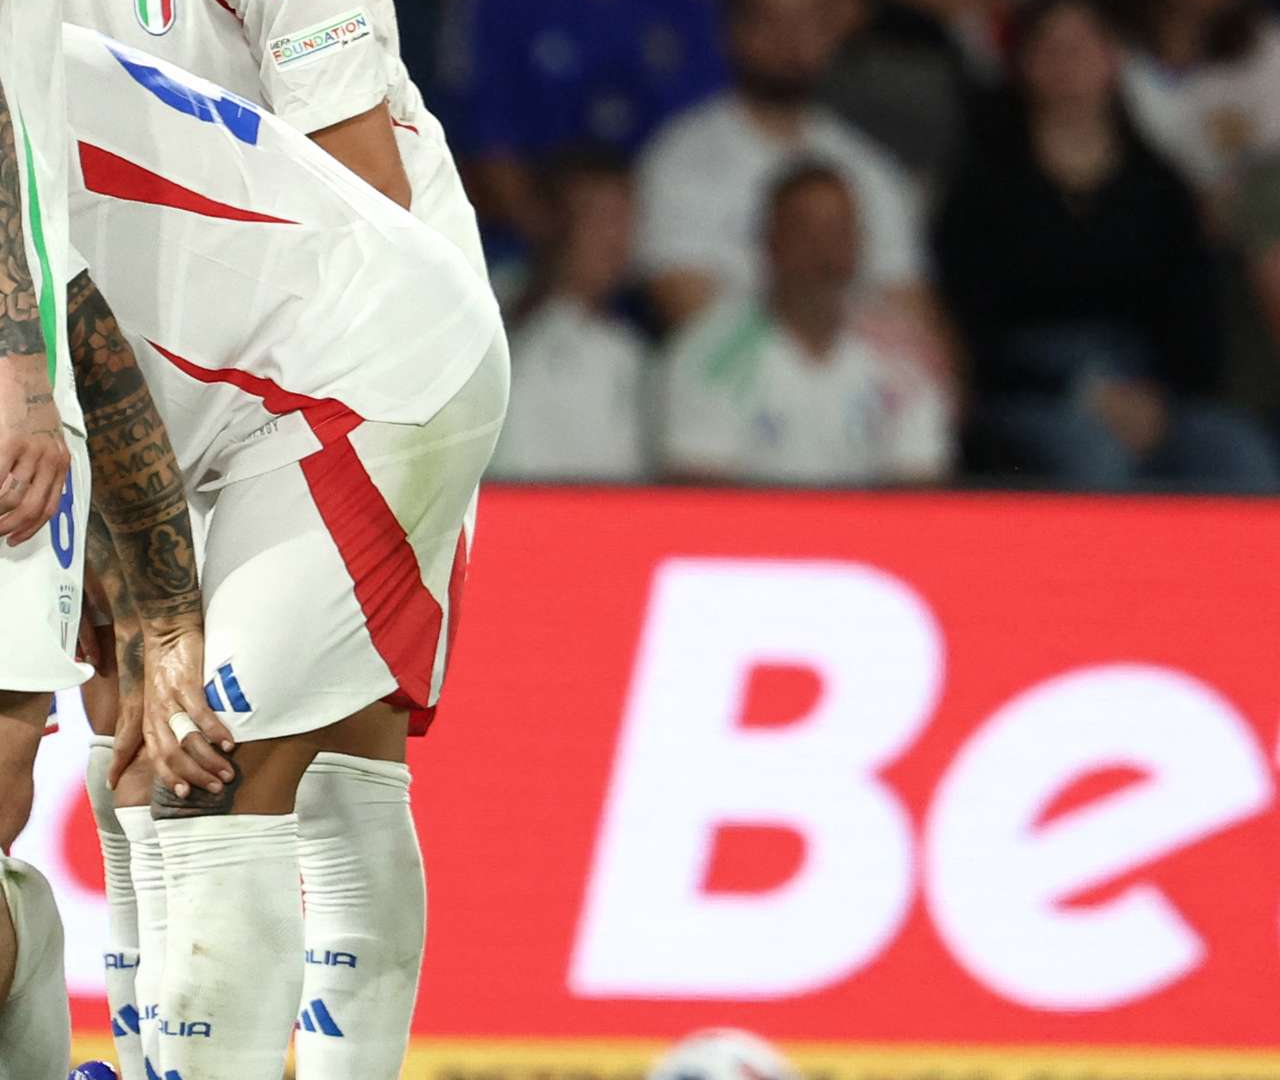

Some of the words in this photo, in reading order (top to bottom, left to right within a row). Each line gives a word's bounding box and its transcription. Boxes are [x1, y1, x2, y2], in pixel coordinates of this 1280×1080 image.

[272, 16, 368, 62] FOUNDATION
[564, 556, 1280, 1012] Be
[159, 1019, 211, 1037] LIA
